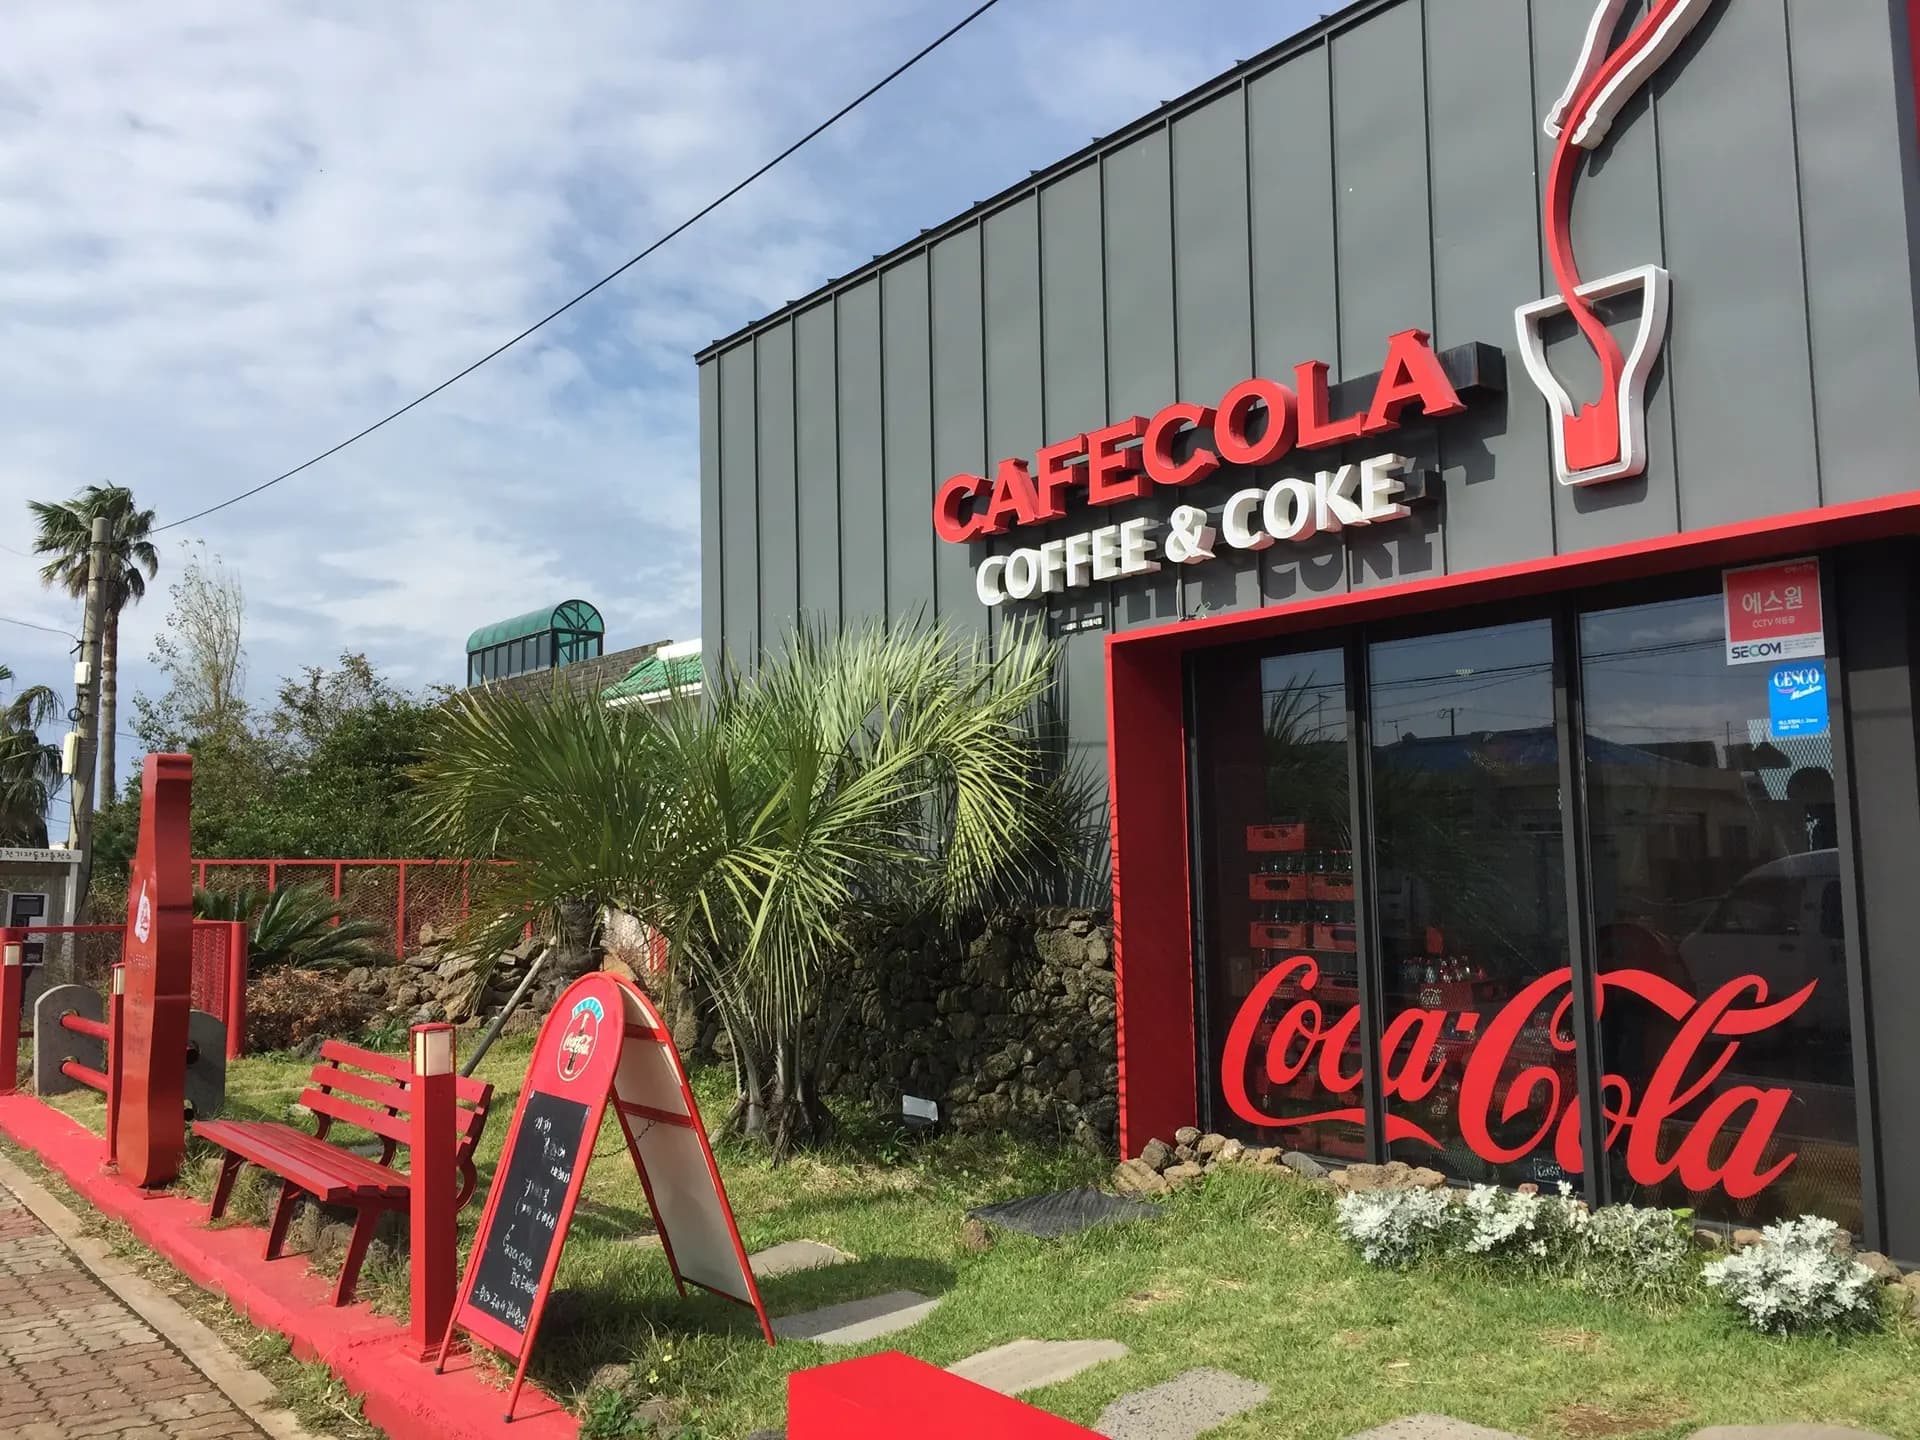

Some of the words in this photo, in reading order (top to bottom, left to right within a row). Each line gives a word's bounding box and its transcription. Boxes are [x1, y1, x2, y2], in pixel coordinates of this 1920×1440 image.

[933, 328, 1467, 544] CAFECOLA
[975, 516, 1161, 606] COFFEE
[1165, 504, 1217, 565] &
[1222, 453, 1412, 552] COKE
[1742, 586, 1804, 614] 에스원
[1752, 619, 1773, 629] CCTV
[1731, 642, 1782, 659] SECOM
[1774, 668, 1820, 688] CESCO
